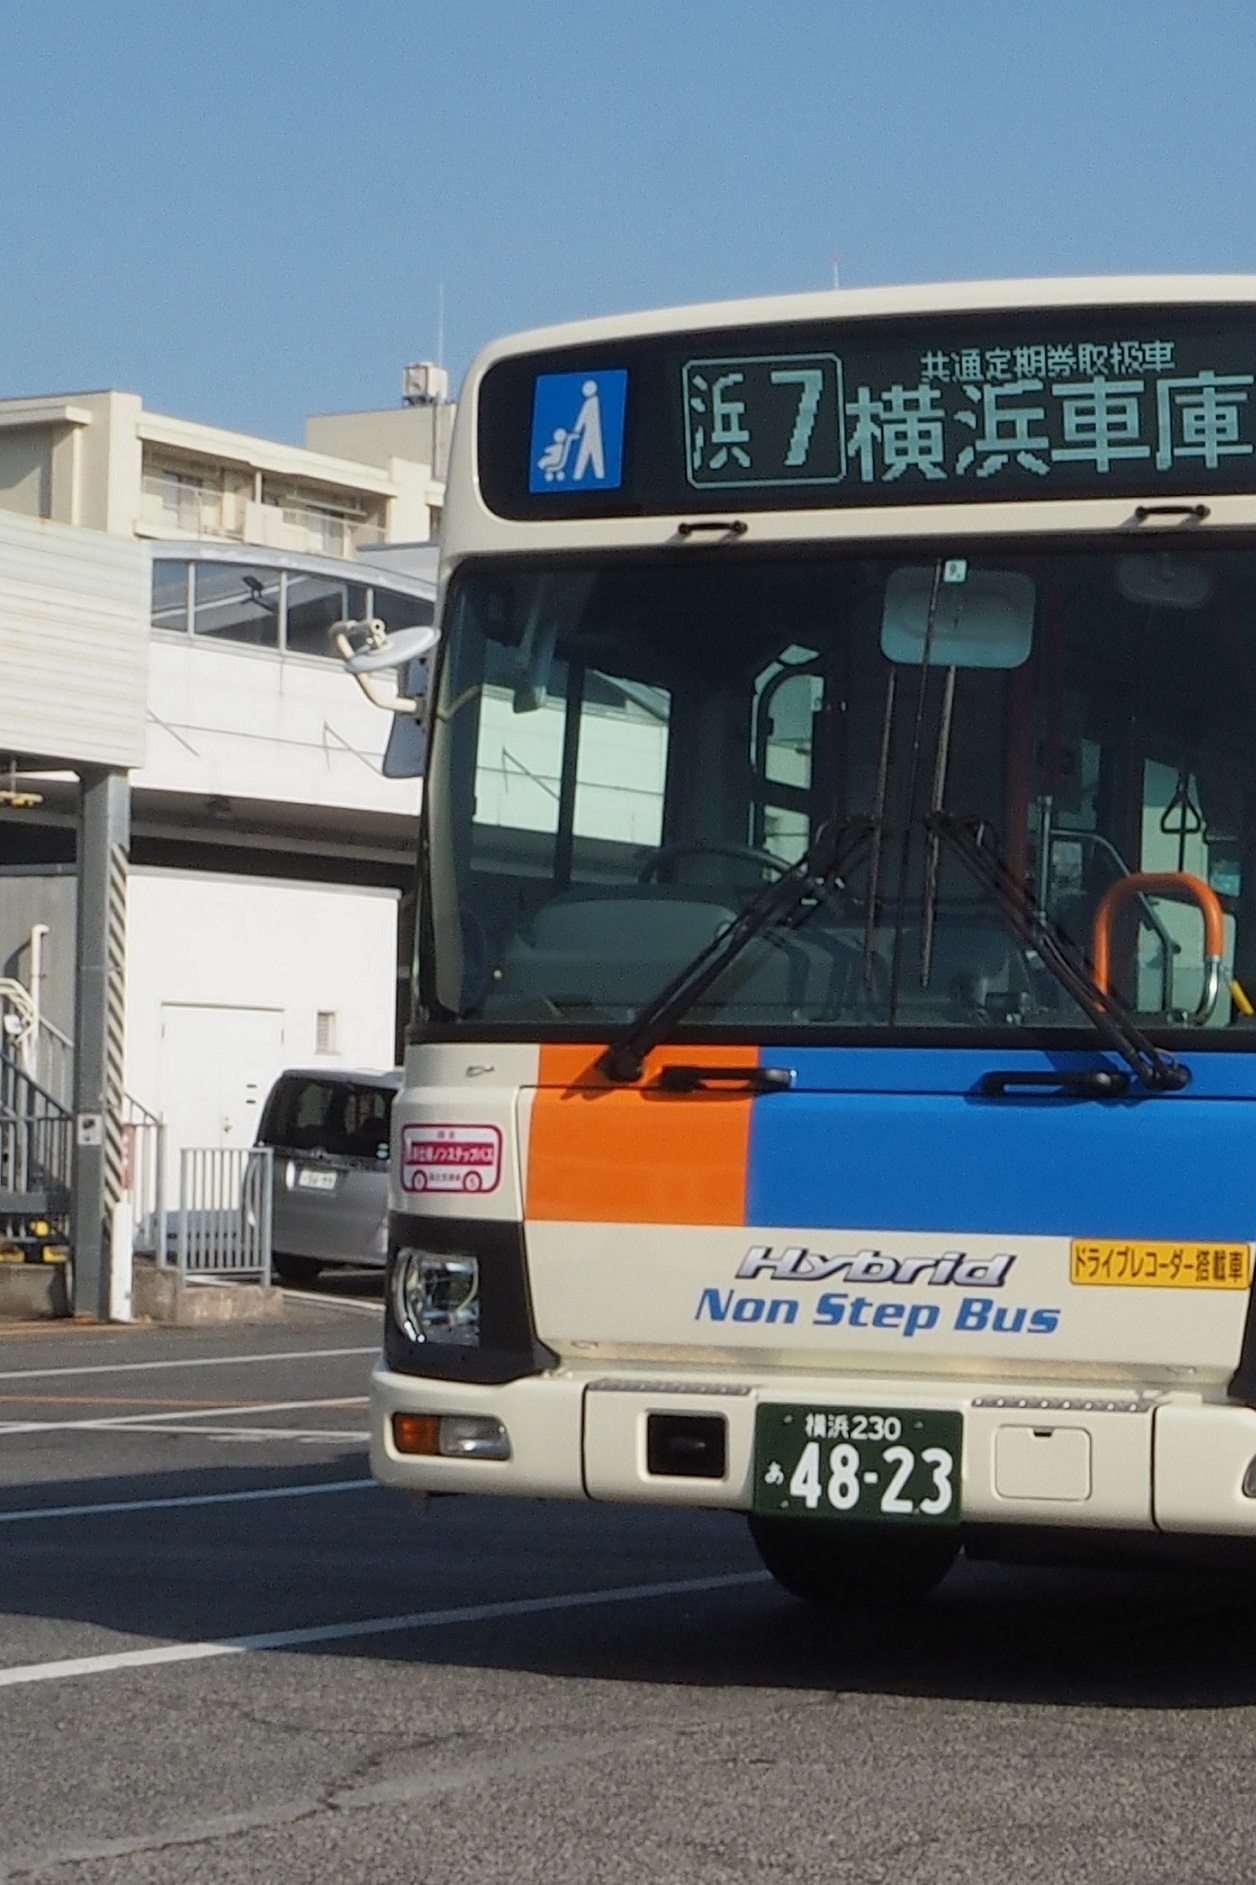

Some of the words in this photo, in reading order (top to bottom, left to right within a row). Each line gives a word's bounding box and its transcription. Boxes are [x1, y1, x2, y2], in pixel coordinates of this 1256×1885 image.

[691, 372, 751, 469] 浜
[770, 369, 824, 467] 7
[846, 371, 1255, 481] 横浜車庫
[734, 1245, 1017, 1288] Hybrid
[1074, 1245, 1244, 1283] ドライブレコーダー搭載車
[695, 1288, 799, 1325] Non
[812, 1292, 941, 1337] Step
[953, 1297, 1062, 1335] Bus
[764, 1460, 785, 1486] あ
[789, 1441, 954, 1515] 48-23
